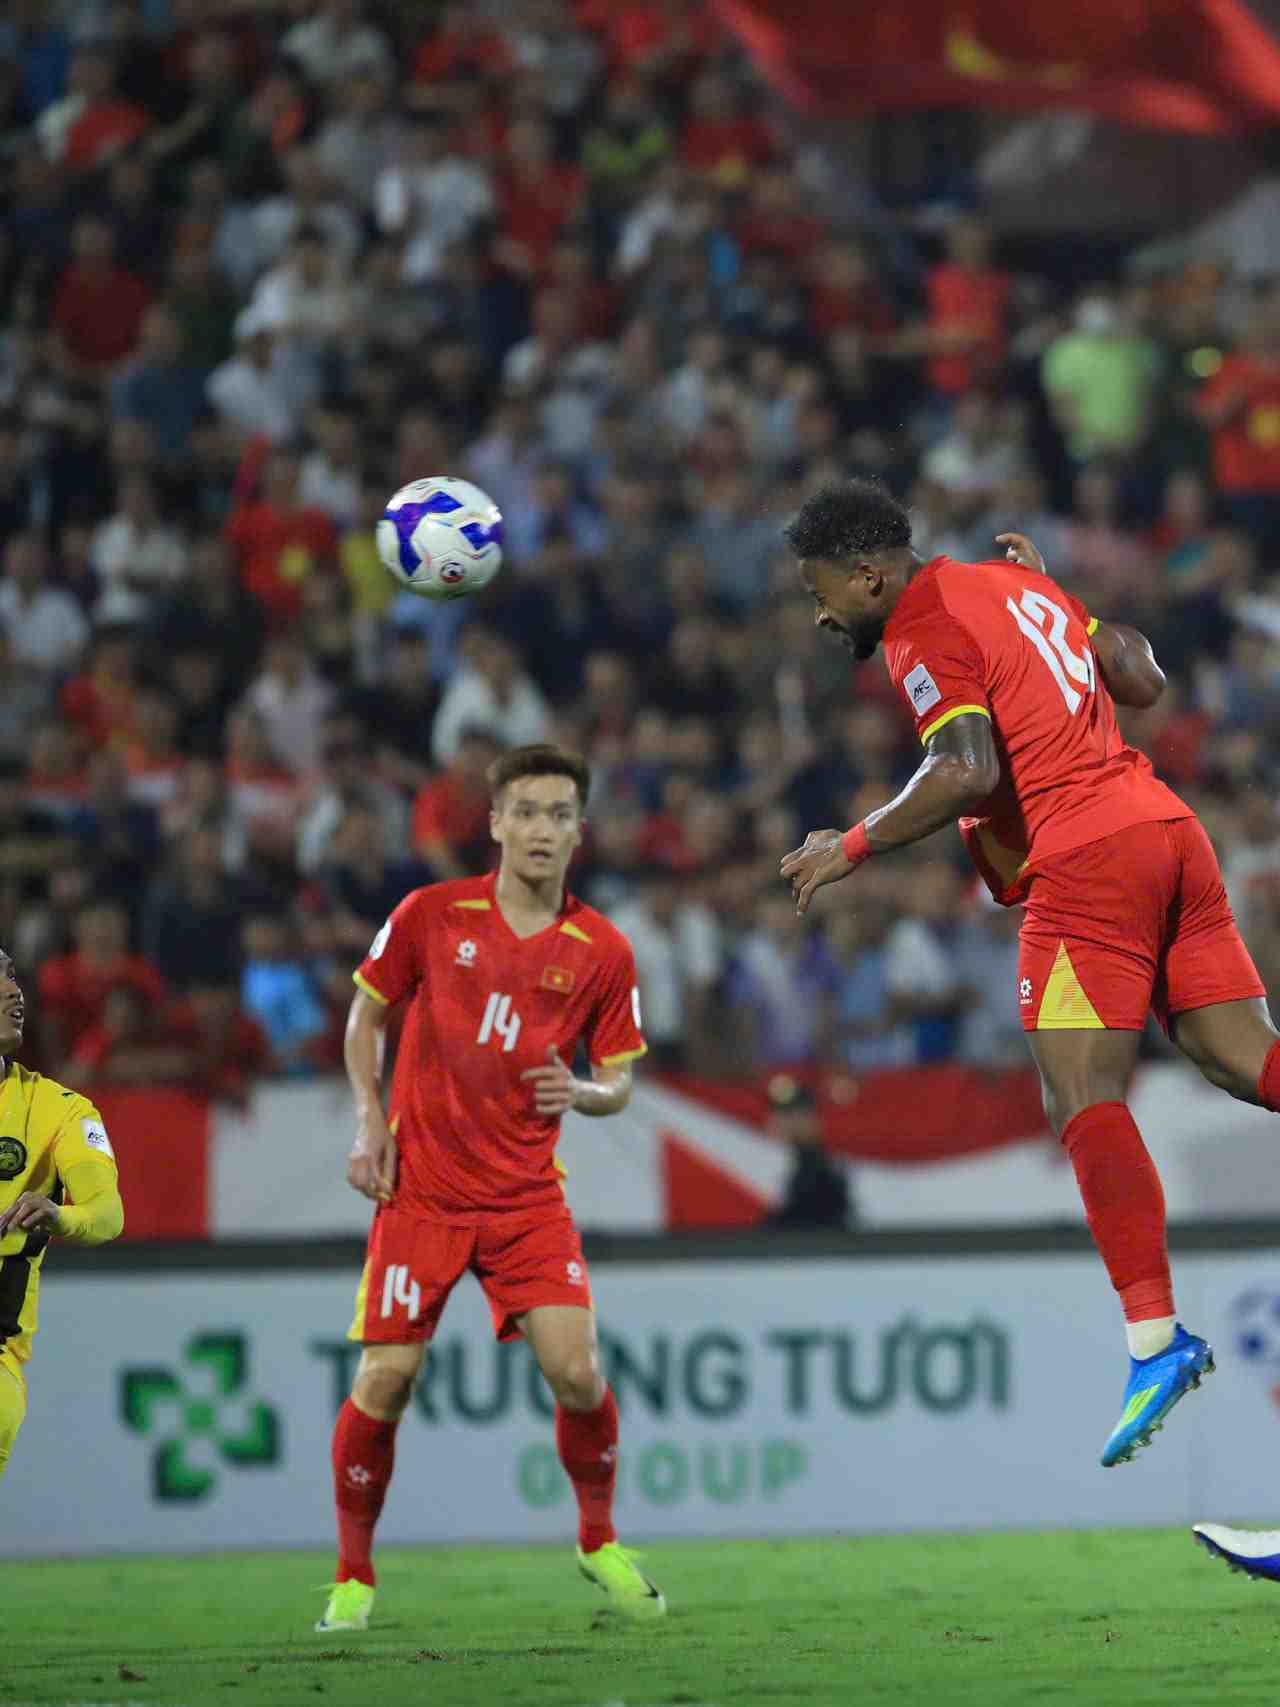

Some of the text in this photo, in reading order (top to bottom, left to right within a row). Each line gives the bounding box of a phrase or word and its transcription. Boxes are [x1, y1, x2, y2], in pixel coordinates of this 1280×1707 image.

[1006, 589, 1096, 716] 12
[477, 992, 521, 1052] 14
[381, 1264, 420, 1320] 14
[514, 1441, 809, 1507] GOUP
